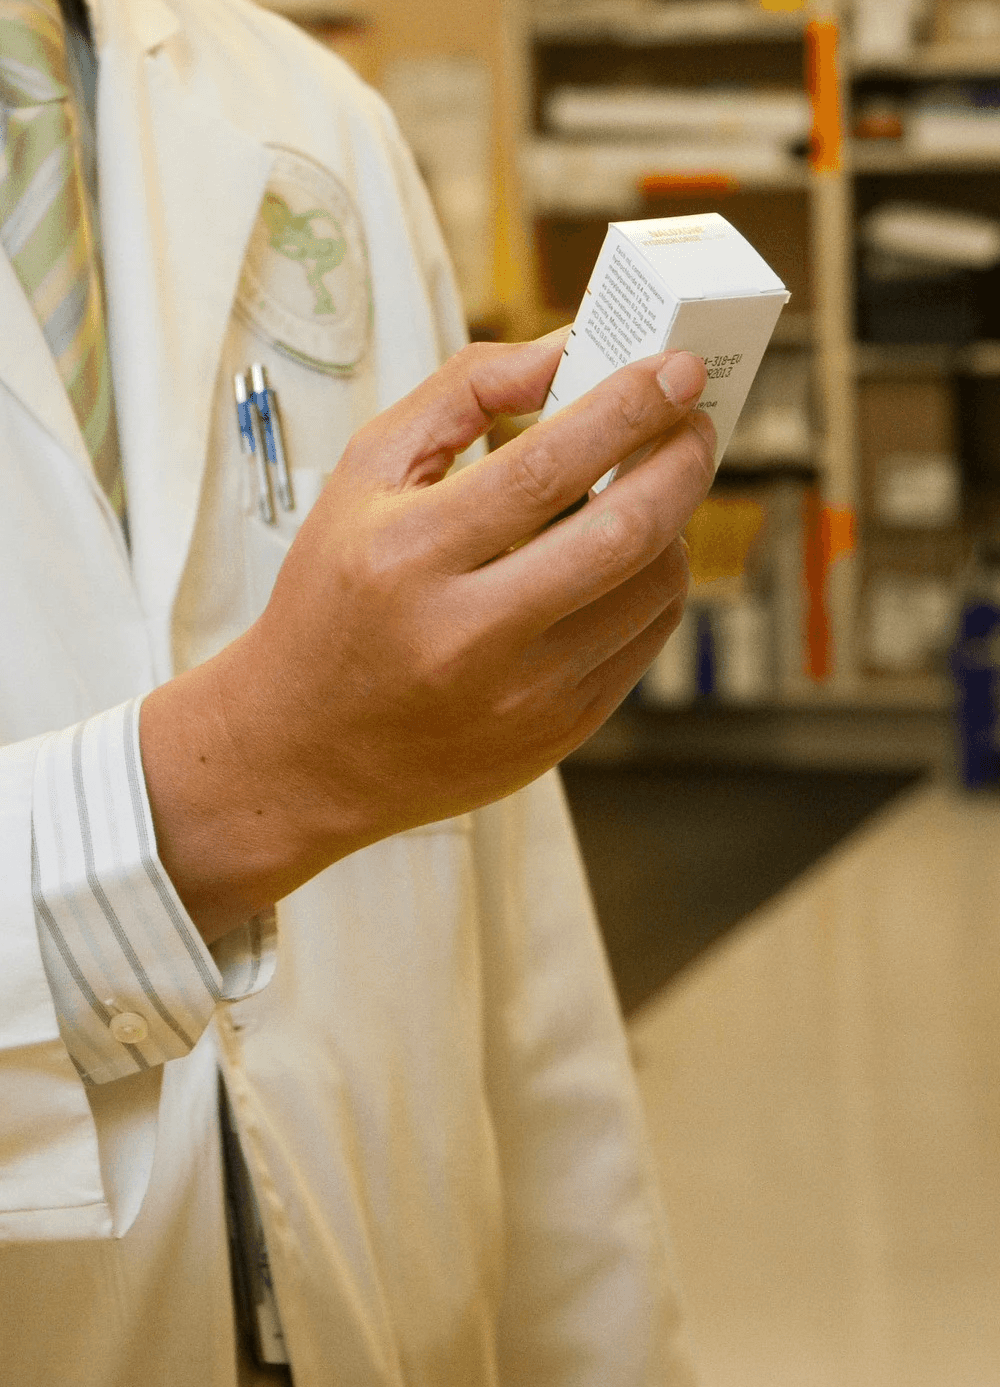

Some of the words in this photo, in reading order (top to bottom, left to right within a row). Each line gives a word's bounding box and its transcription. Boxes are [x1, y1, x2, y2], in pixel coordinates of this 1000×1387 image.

[632, 265, 647, 285] contains
[613, 310, 626, 324] added
[625, 322, 629, 330] to
[648, 310, 656, 320] and
[609, 316, 618, 330] May
[618, 328, 632, 345] contain
[644, 319, 656, 333] added
